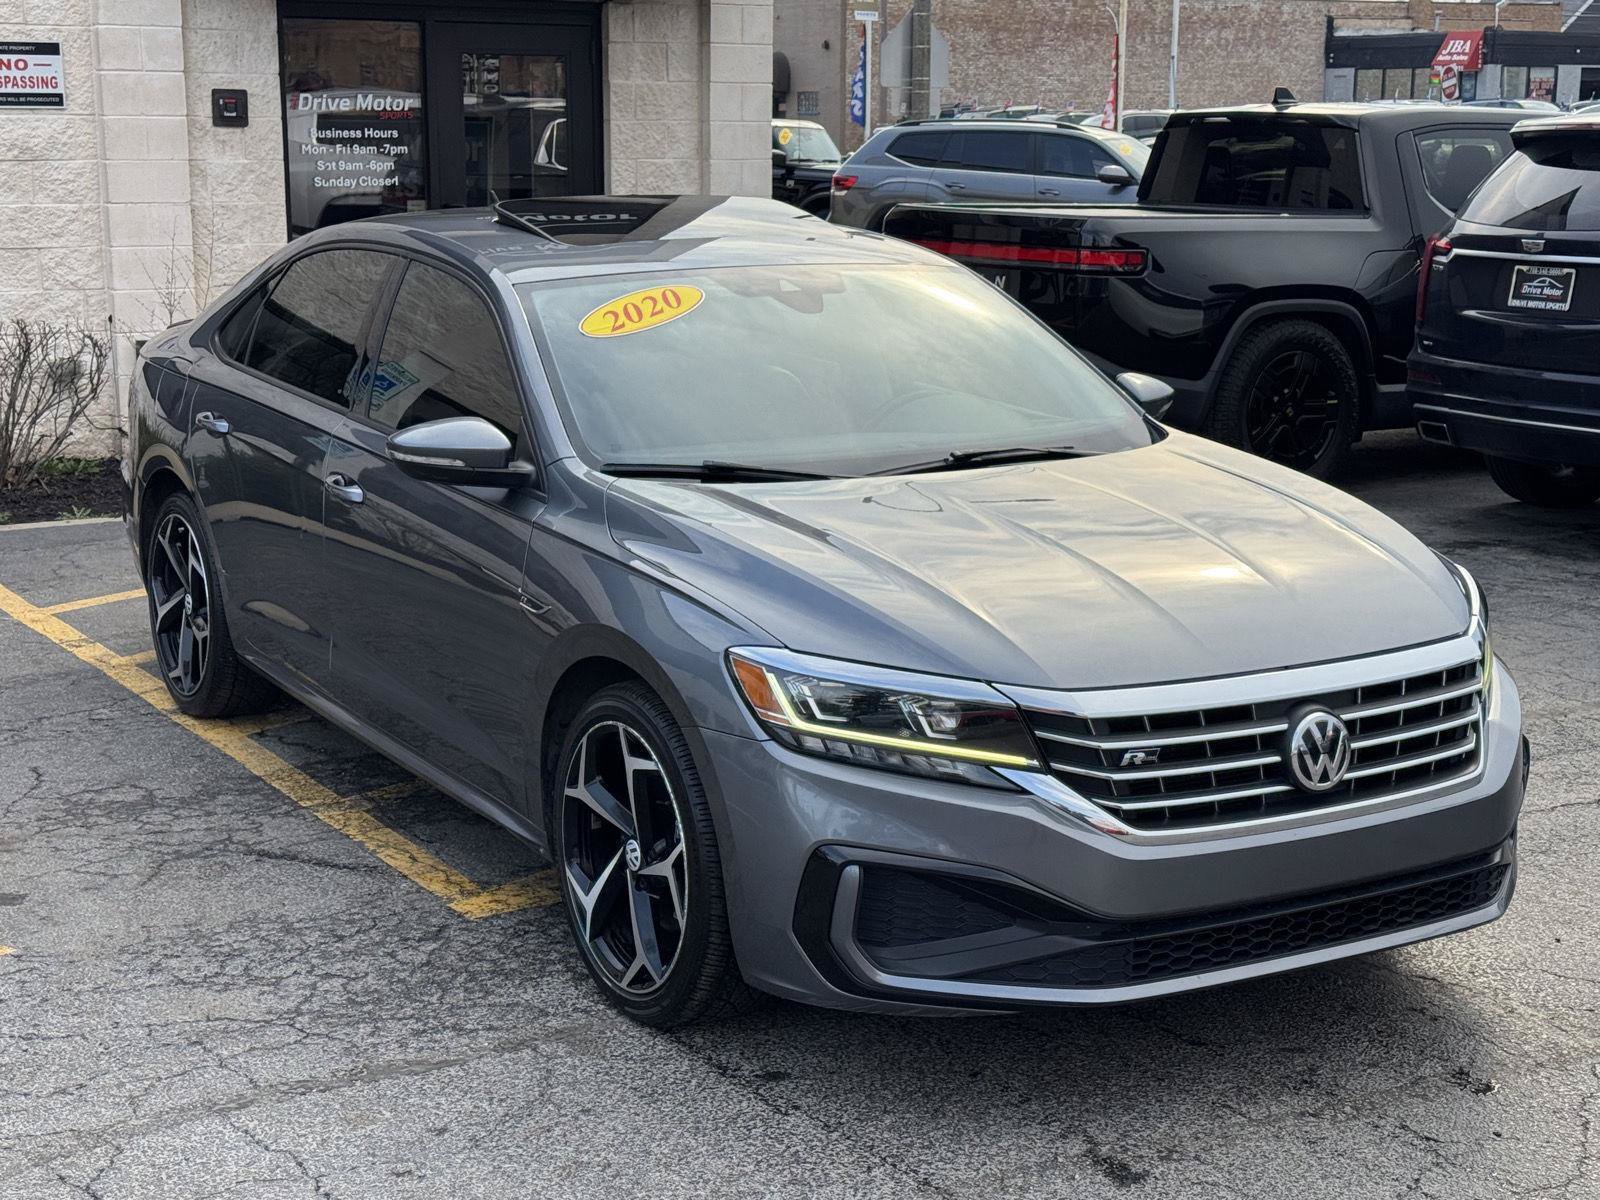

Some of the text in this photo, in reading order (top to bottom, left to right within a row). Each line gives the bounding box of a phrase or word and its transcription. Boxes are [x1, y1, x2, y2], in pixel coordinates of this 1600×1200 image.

[1441, 39, 1471, 55] JBA
[0, 58, 29, 71] NO
[356, 93, 414, 111] Motor
[379, 111, 414, 120] SPORTS
[310, 127, 399, 139] Business Hours
[301, 144, 327, 155] Mon
[335, 144, 351, 155] Fri
[352, 144, 378, 155] 9am
[316, 160, 337, 171] Sat
[338, 160, 364, 171] 9am
[313, 175, 399, 188] Sunday Closed
[1543, 286, 1564, 296] Motor
[602, 288, 682, 333] 2020
